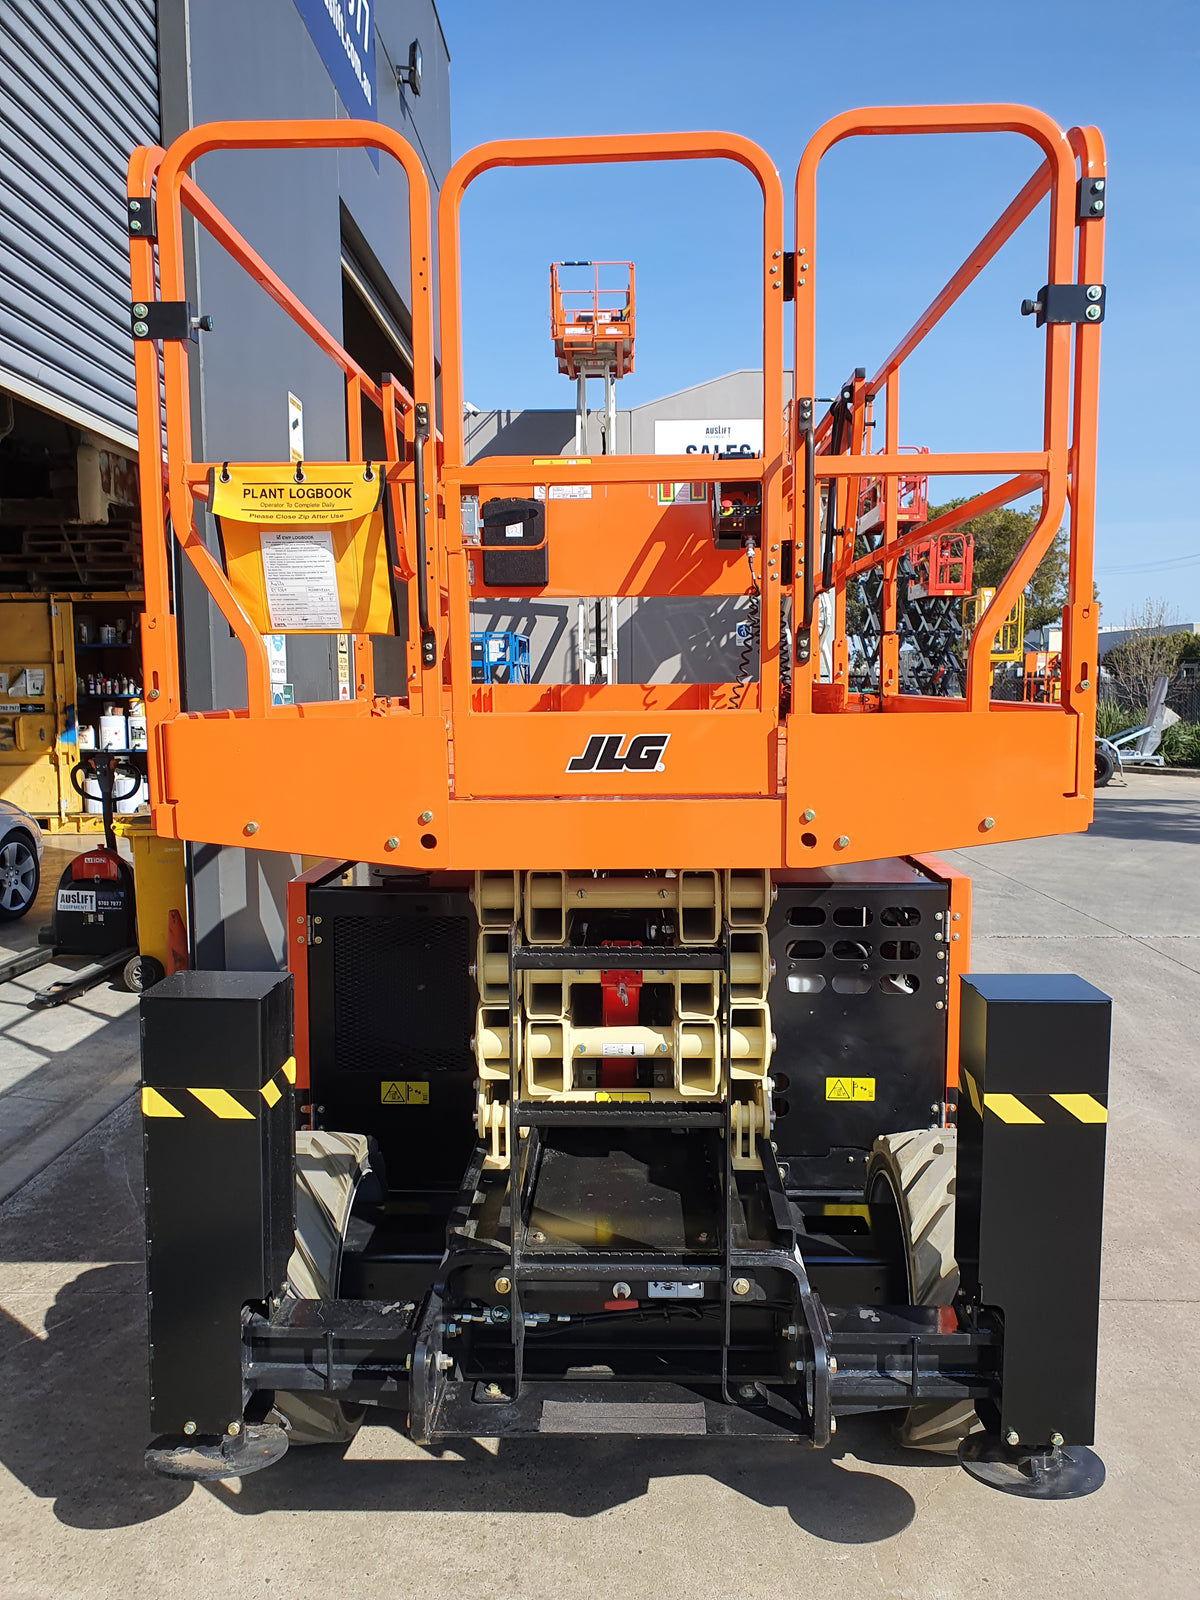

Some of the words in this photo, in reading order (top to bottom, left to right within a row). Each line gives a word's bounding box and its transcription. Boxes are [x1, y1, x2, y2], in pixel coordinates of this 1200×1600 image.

[705, 425, 731, 435] AUSLIFT
[243, 488, 284, 499] PLANT
[289, 487, 352, 499] LOGBOOK
[565, 734, 671, 772] JLG
[60, 891, 95, 907] AUSLIFT
[59, 903, 88, 911] EQUIPMENT
